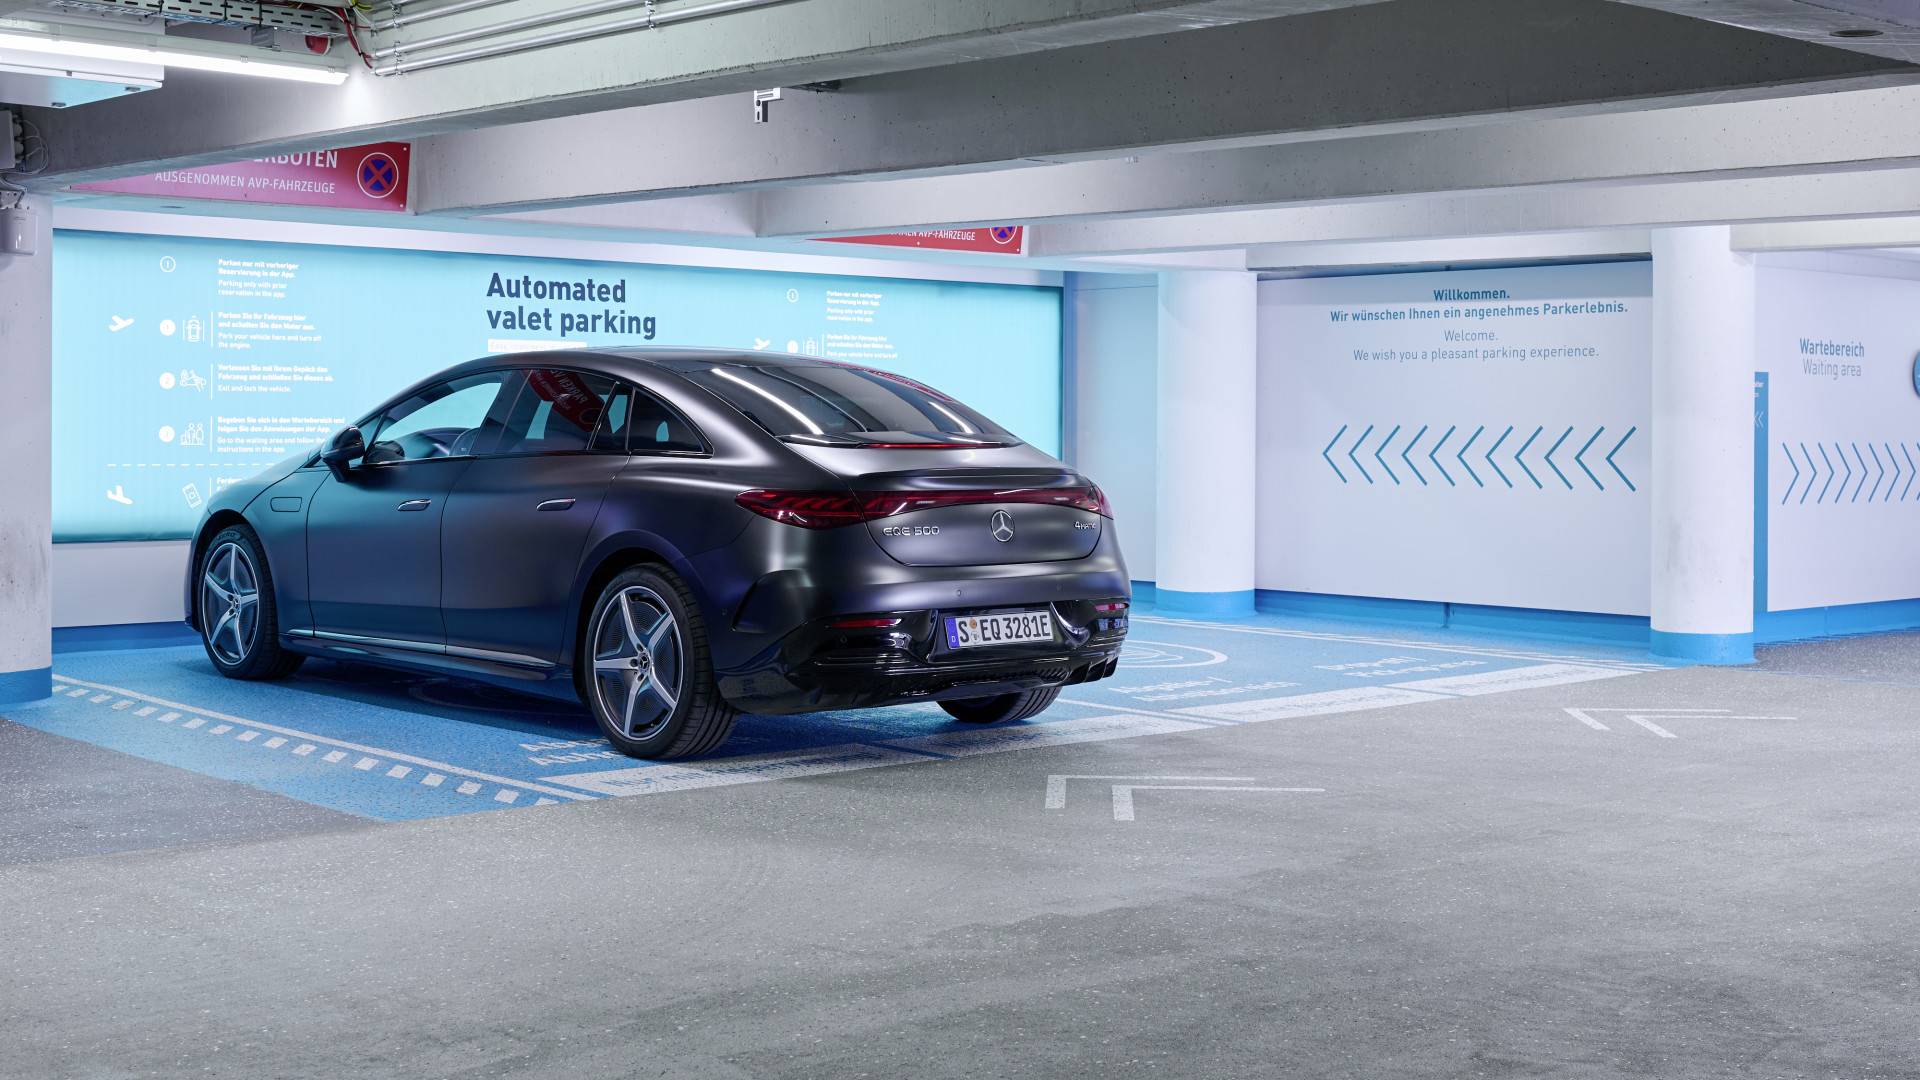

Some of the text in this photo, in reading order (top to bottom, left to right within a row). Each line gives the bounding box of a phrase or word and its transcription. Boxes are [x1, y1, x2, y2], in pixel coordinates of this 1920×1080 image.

[155, 171, 336, 194] AUSGENOMMEN AVP-FAHRZEUGE
[218, 280, 242, 288] Parking
[486, 272, 626, 303] Automated
[1433, 288, 1510, 301] Willkommen.
[1330, 301, 1628, 322] Wir wünschen Ihnen ein angenehmes Parkerlebnis.
[486, 305, 656, 340] valet parking
[1444, 330, 1499, 342] Welcome.
[1353, 346, 1600, 362] We wish you a pleasant parking experience.
[1799, 338, 1864, 357] Wartebereich
[1803, 359, 1862, 380] Waiting area
[882, 525, 940, 537] EQE 500
[957, 613, 1051, 643] S EQ 3281E
[951, 635, 957, 643] D
